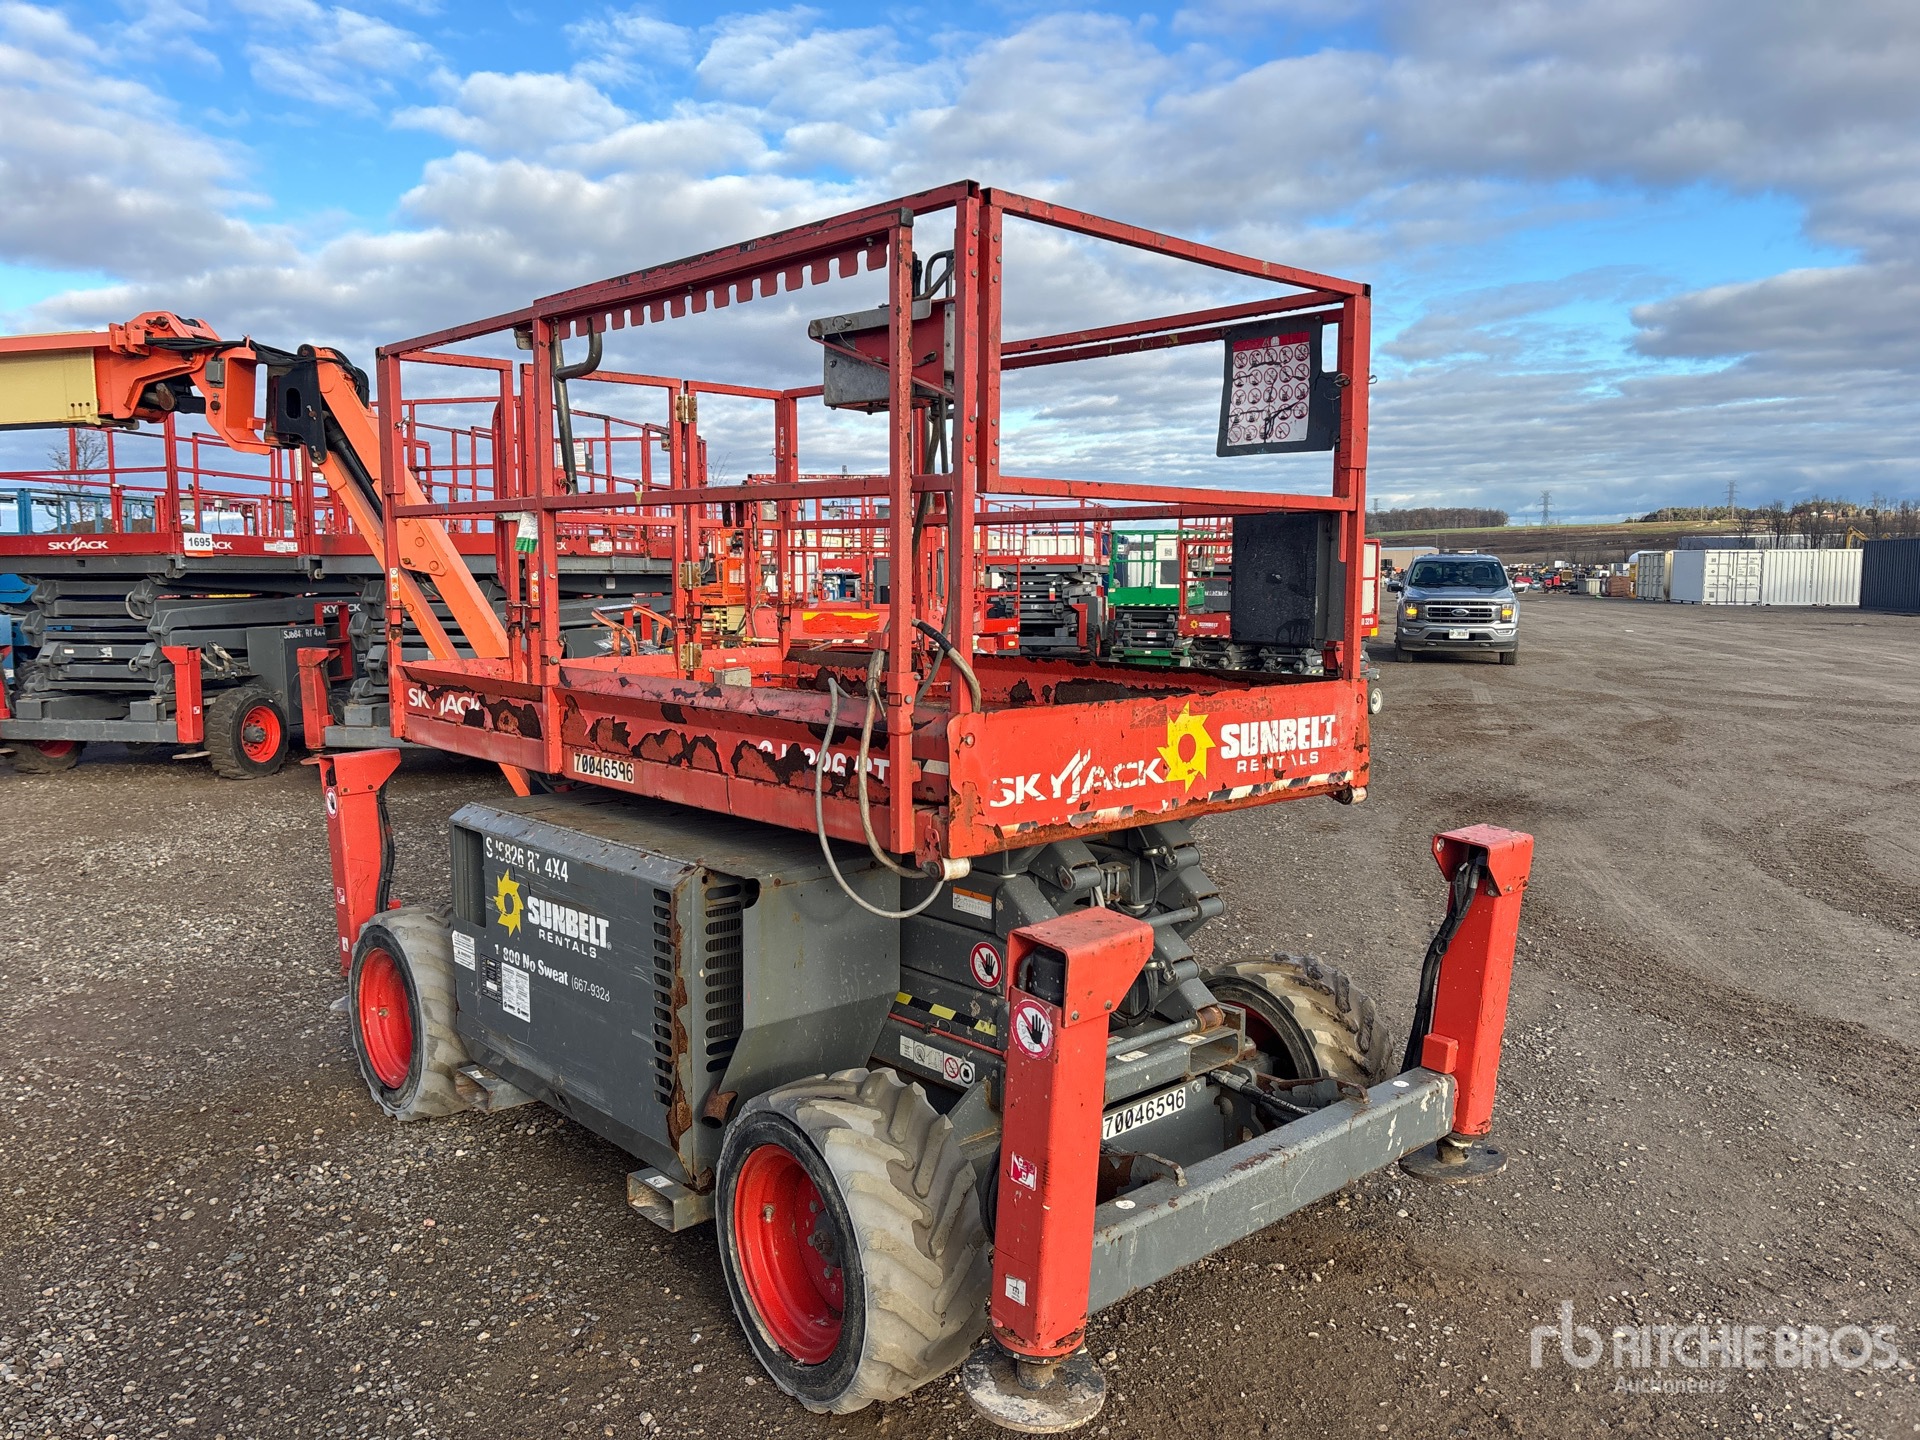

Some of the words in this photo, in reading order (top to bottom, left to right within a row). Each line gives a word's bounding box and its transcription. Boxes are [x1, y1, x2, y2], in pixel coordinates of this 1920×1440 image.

[48, 536, 109, 552] SKYJACK
[188, 537, 211, 547] 1695
[1220, 714, 1336, 759] SUNBELT
[575, 753, 633, 782] 70046596
[989, 748, 1166, 807] SKYJACK
[527, 895, 609, 949] SUNBELT
[538, 928, 597, 959] RENTALS
[494, 944, 499, 955] 1
[503, 947, 521, 966] 800
[522, 953, 536, 972] No
[537, 959, 569, 986] Sweat
[1104, 1089, 1184, 1138] 70046596
